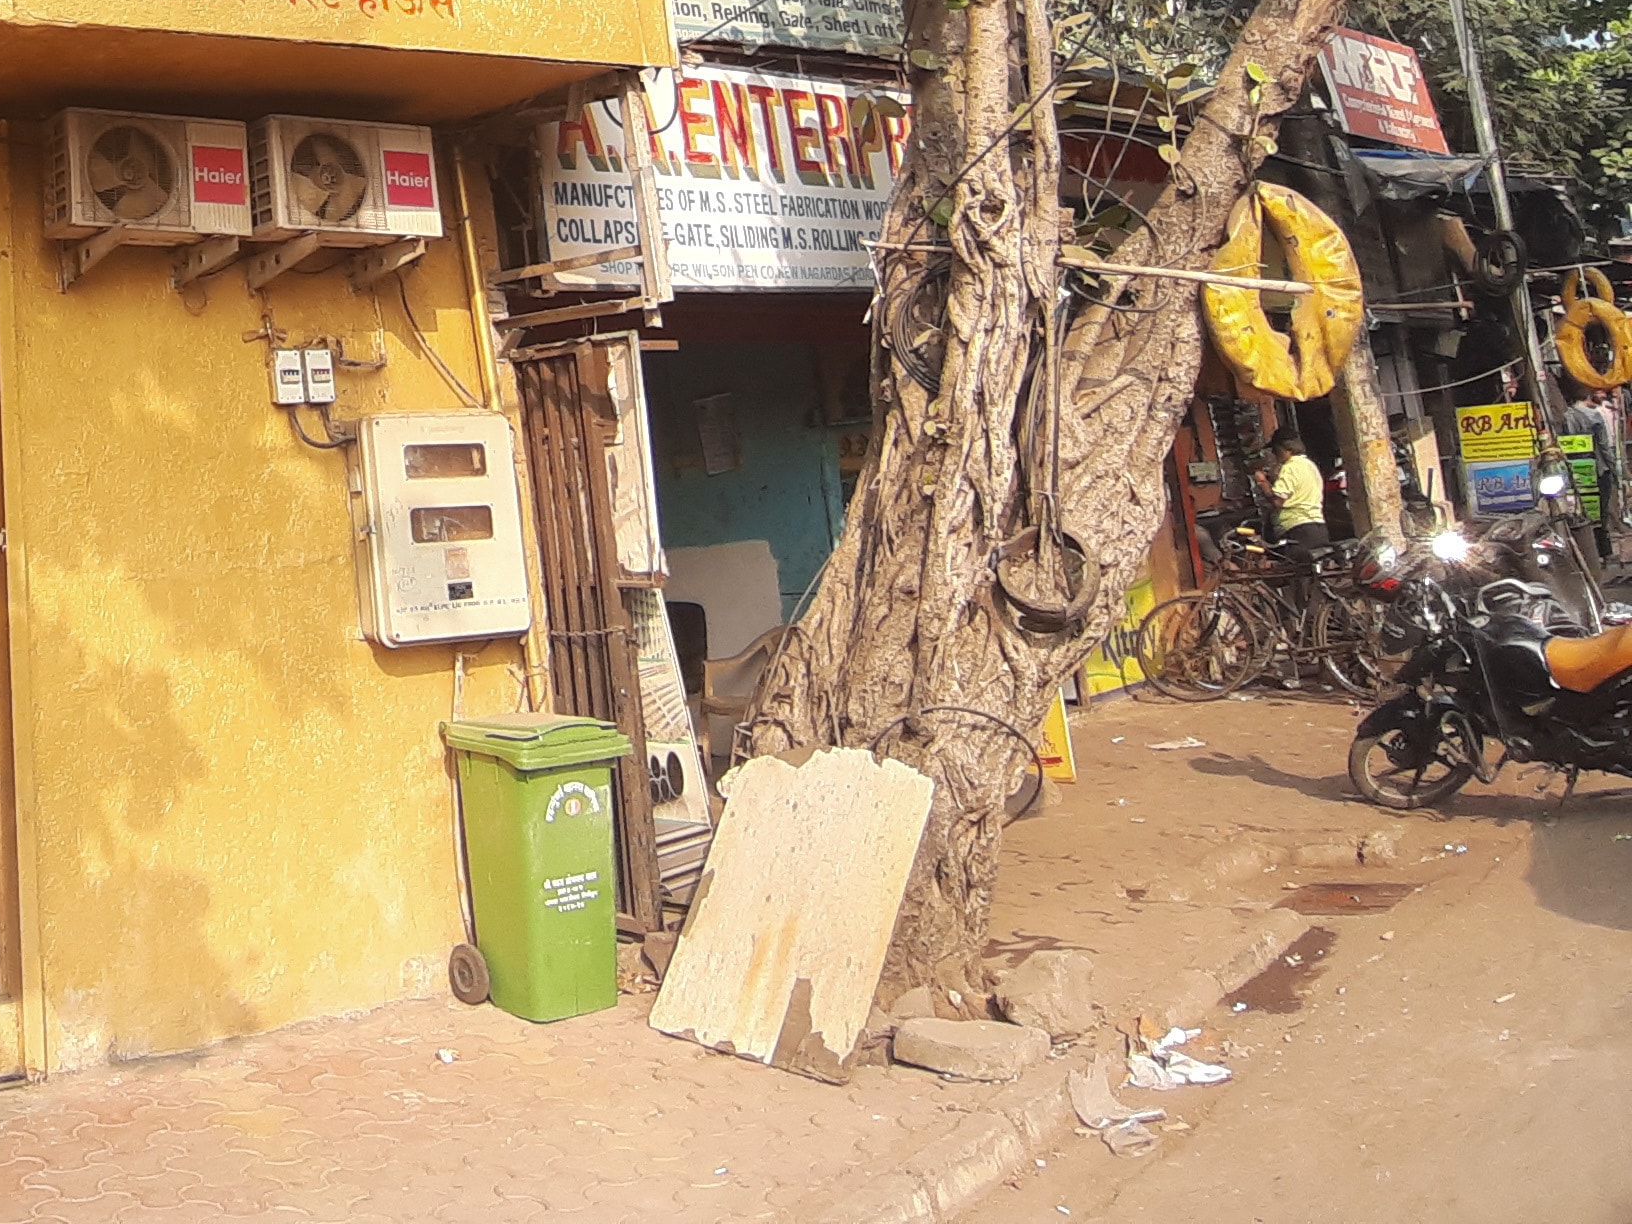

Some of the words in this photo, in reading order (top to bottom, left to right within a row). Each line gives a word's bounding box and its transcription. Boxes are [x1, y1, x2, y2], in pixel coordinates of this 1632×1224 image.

[194, 166, 242, 185] Haier
[386, 169, 431, 188] Haier
[678, 189, 696, 211] OF
[780, 195, 859, 220] FABRICATION
[1461, 415, 1493, 436] RB
